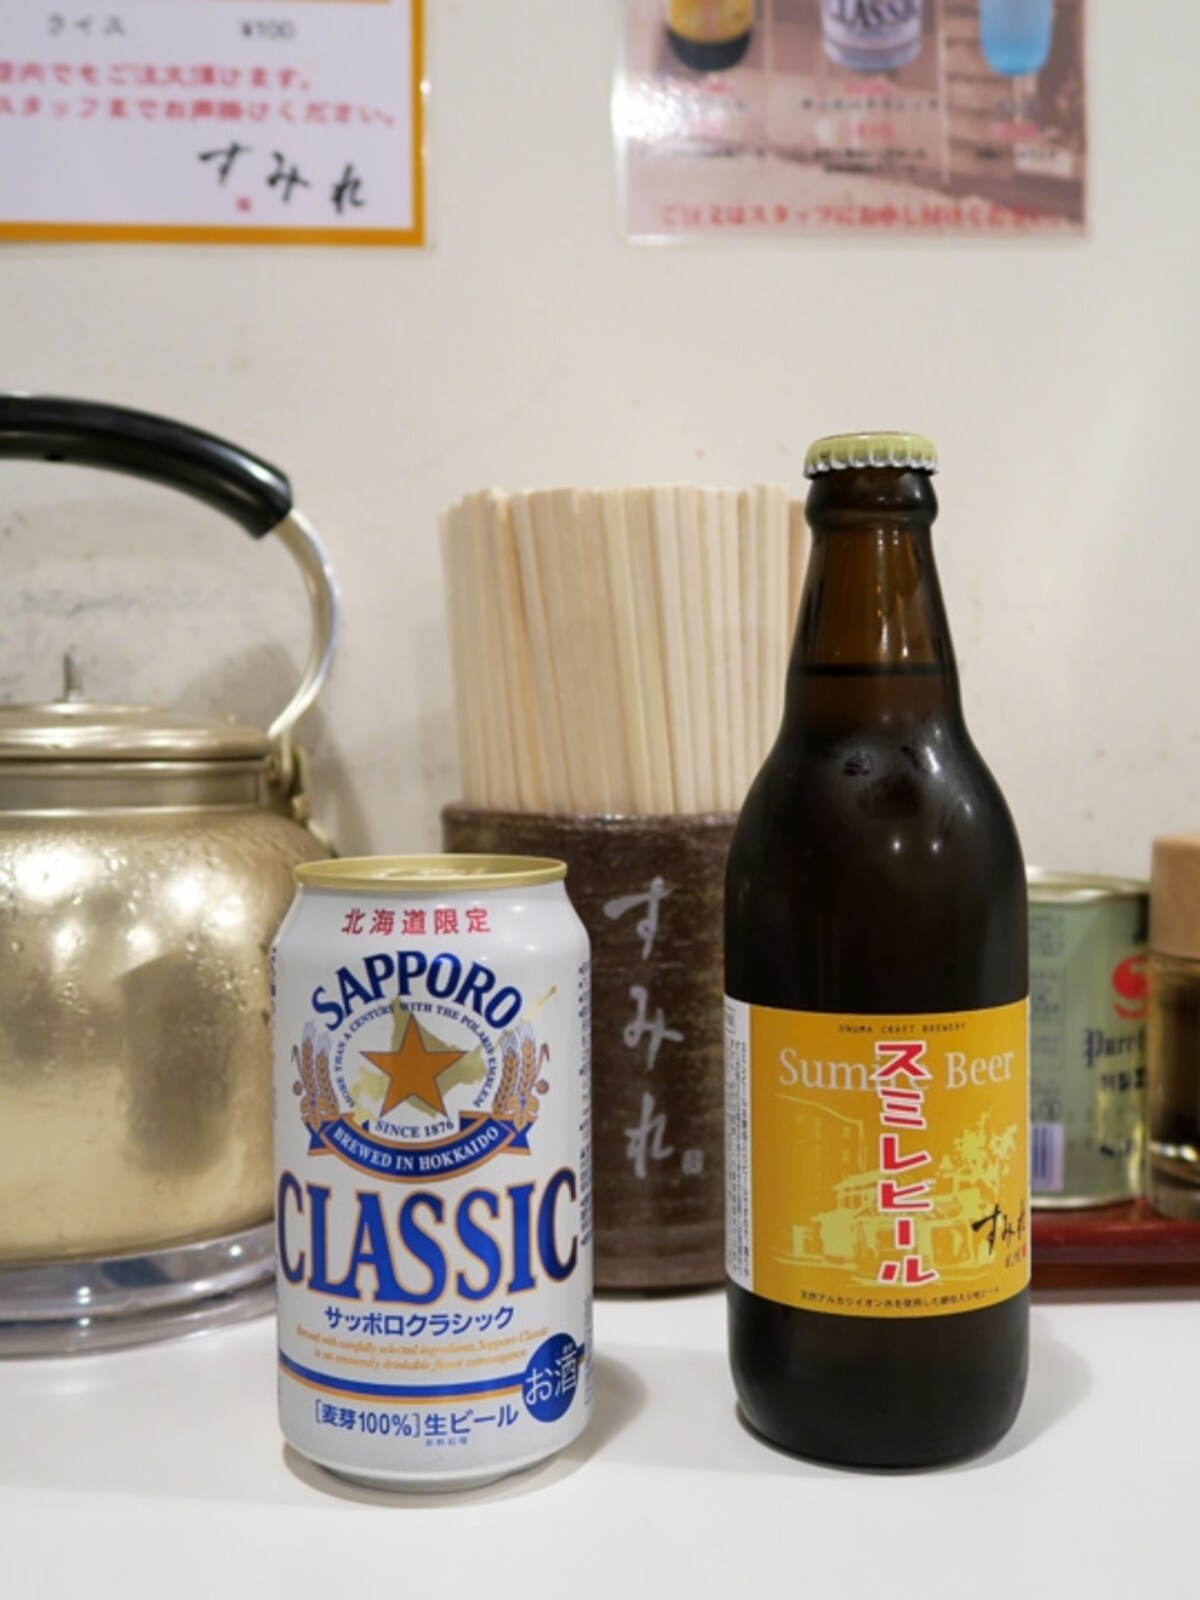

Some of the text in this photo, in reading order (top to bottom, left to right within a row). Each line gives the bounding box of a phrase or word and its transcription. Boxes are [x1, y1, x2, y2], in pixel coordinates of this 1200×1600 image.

[197, 141, 366, 214] すみれ
[341, 908, 492, 936] 北海道限定
[311, 950, 523, 1032] SAPPORO
[334, 1040, 346, 1072] THAN
[350, 1004, 394, 1032] CENTURY
[400, 1002, 433, 1013] WITH
[436, 1004, 460, 1021] THE
[603, 875, 684, 1180] すみれ
[838, 1022, 966, 1034] ONUMA CRAFT BREWERY
[945, 1051, 1014, 1090] Beer
[331, 1126, 500, 1172] BREWED IN HOKKAIDO
[375, 1119, 455, 1139] SINCE 1876
[870, 1040, 939, 1286] スミレビール
[277, 1166, 578, 1306] CLASSIC
[325, 1305, 515, 1336] サッポロクラシック
[526, 1348, 577, 1405] お酒
